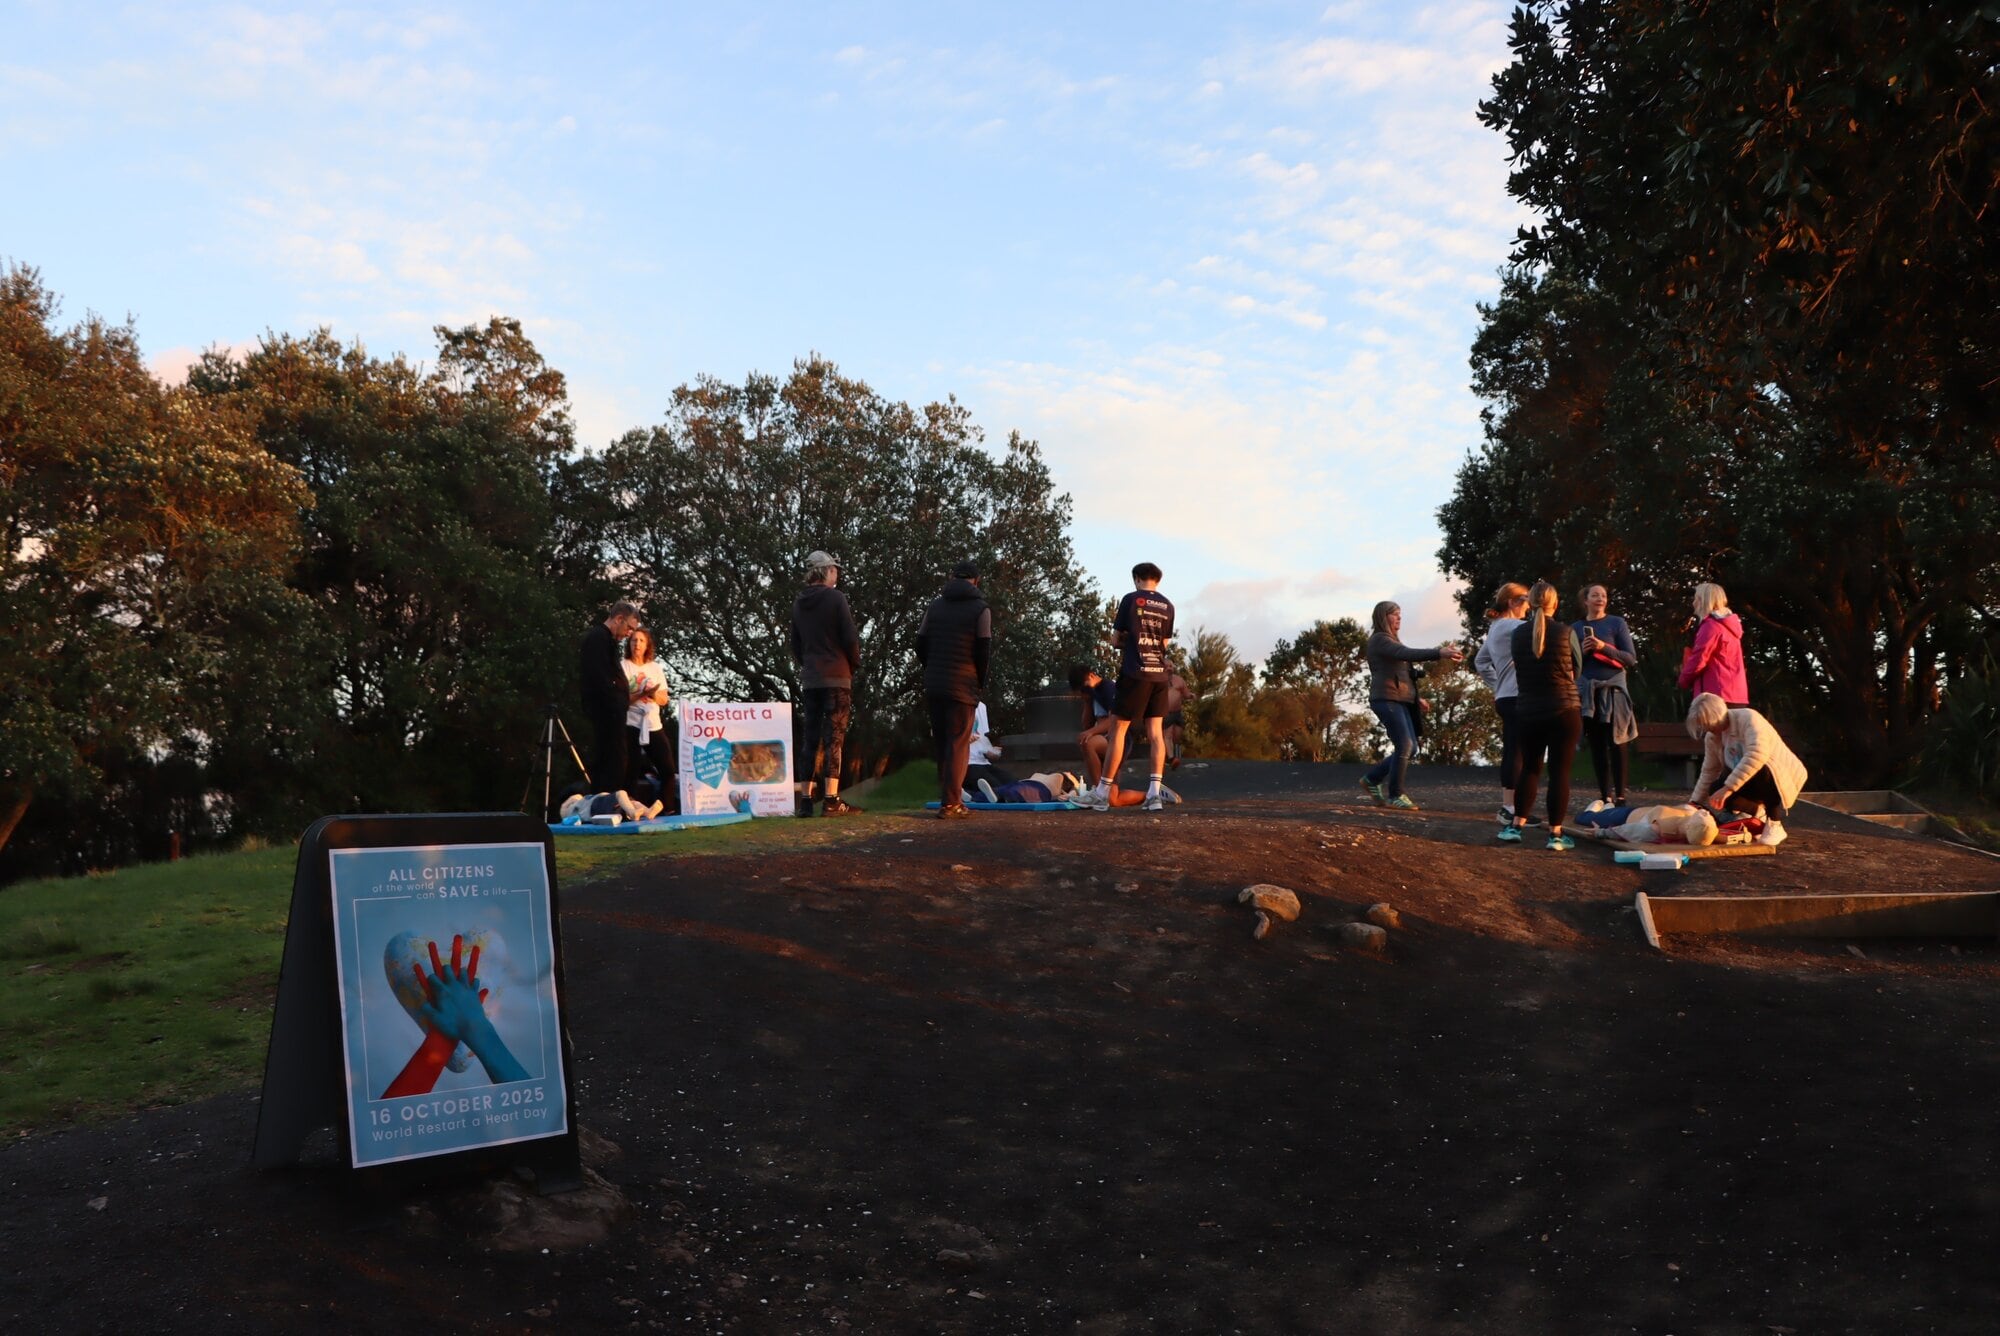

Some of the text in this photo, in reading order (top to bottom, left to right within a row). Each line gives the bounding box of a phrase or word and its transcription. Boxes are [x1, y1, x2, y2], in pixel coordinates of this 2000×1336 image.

[694, 707, 772, 721] Restart a
[692, 724, 726, 741] Day
[389, 865, 495, 882] ALL CITIZENS
[372, 881, 434, 893] of the world
[416, 891, 435, 900] can
[439, 885, 479, 898] SAVE
[492, 887, 507, 896] life
[370, 1087, 545, 1125] 16 OCTOBER 2025
[372, 1107, 548, 1142] World Restart a Heart Day
